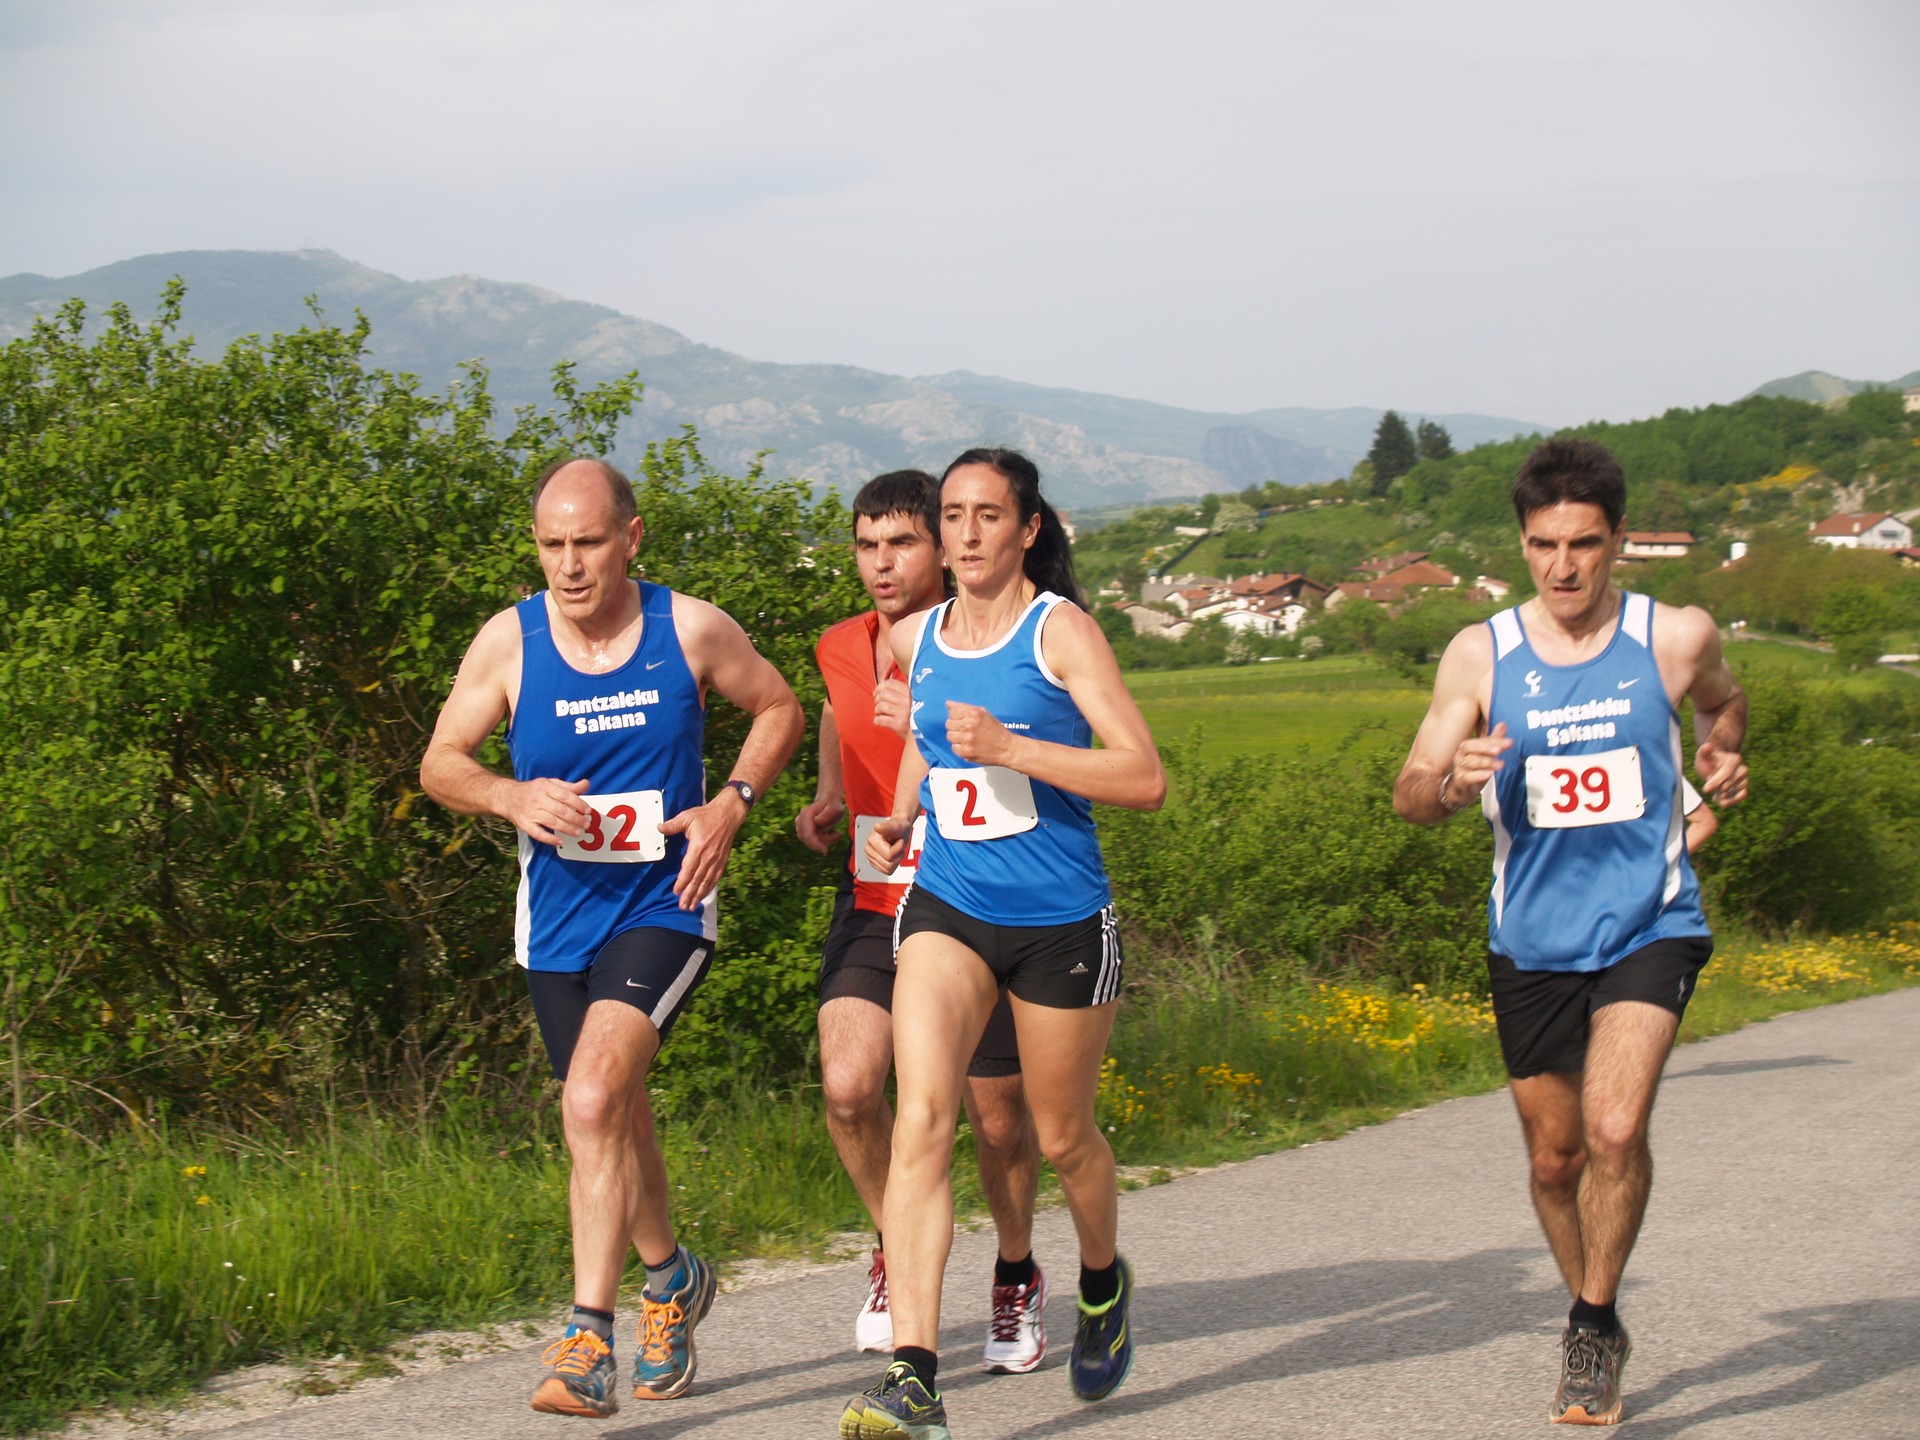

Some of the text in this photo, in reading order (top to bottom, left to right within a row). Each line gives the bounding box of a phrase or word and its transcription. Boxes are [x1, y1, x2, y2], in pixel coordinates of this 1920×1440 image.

[555, 689, 660, 717] Dantzaleku
[1526, 697, 1631, 730] Dantzaleku
[574, 711, 647, 735] Sakana
[1546, 721, 1616, 747] Sakana
[956, 779, 987, 827] 2
[1550, 766, 1611, 814] 39
[577, 804, 641, 852] 32
